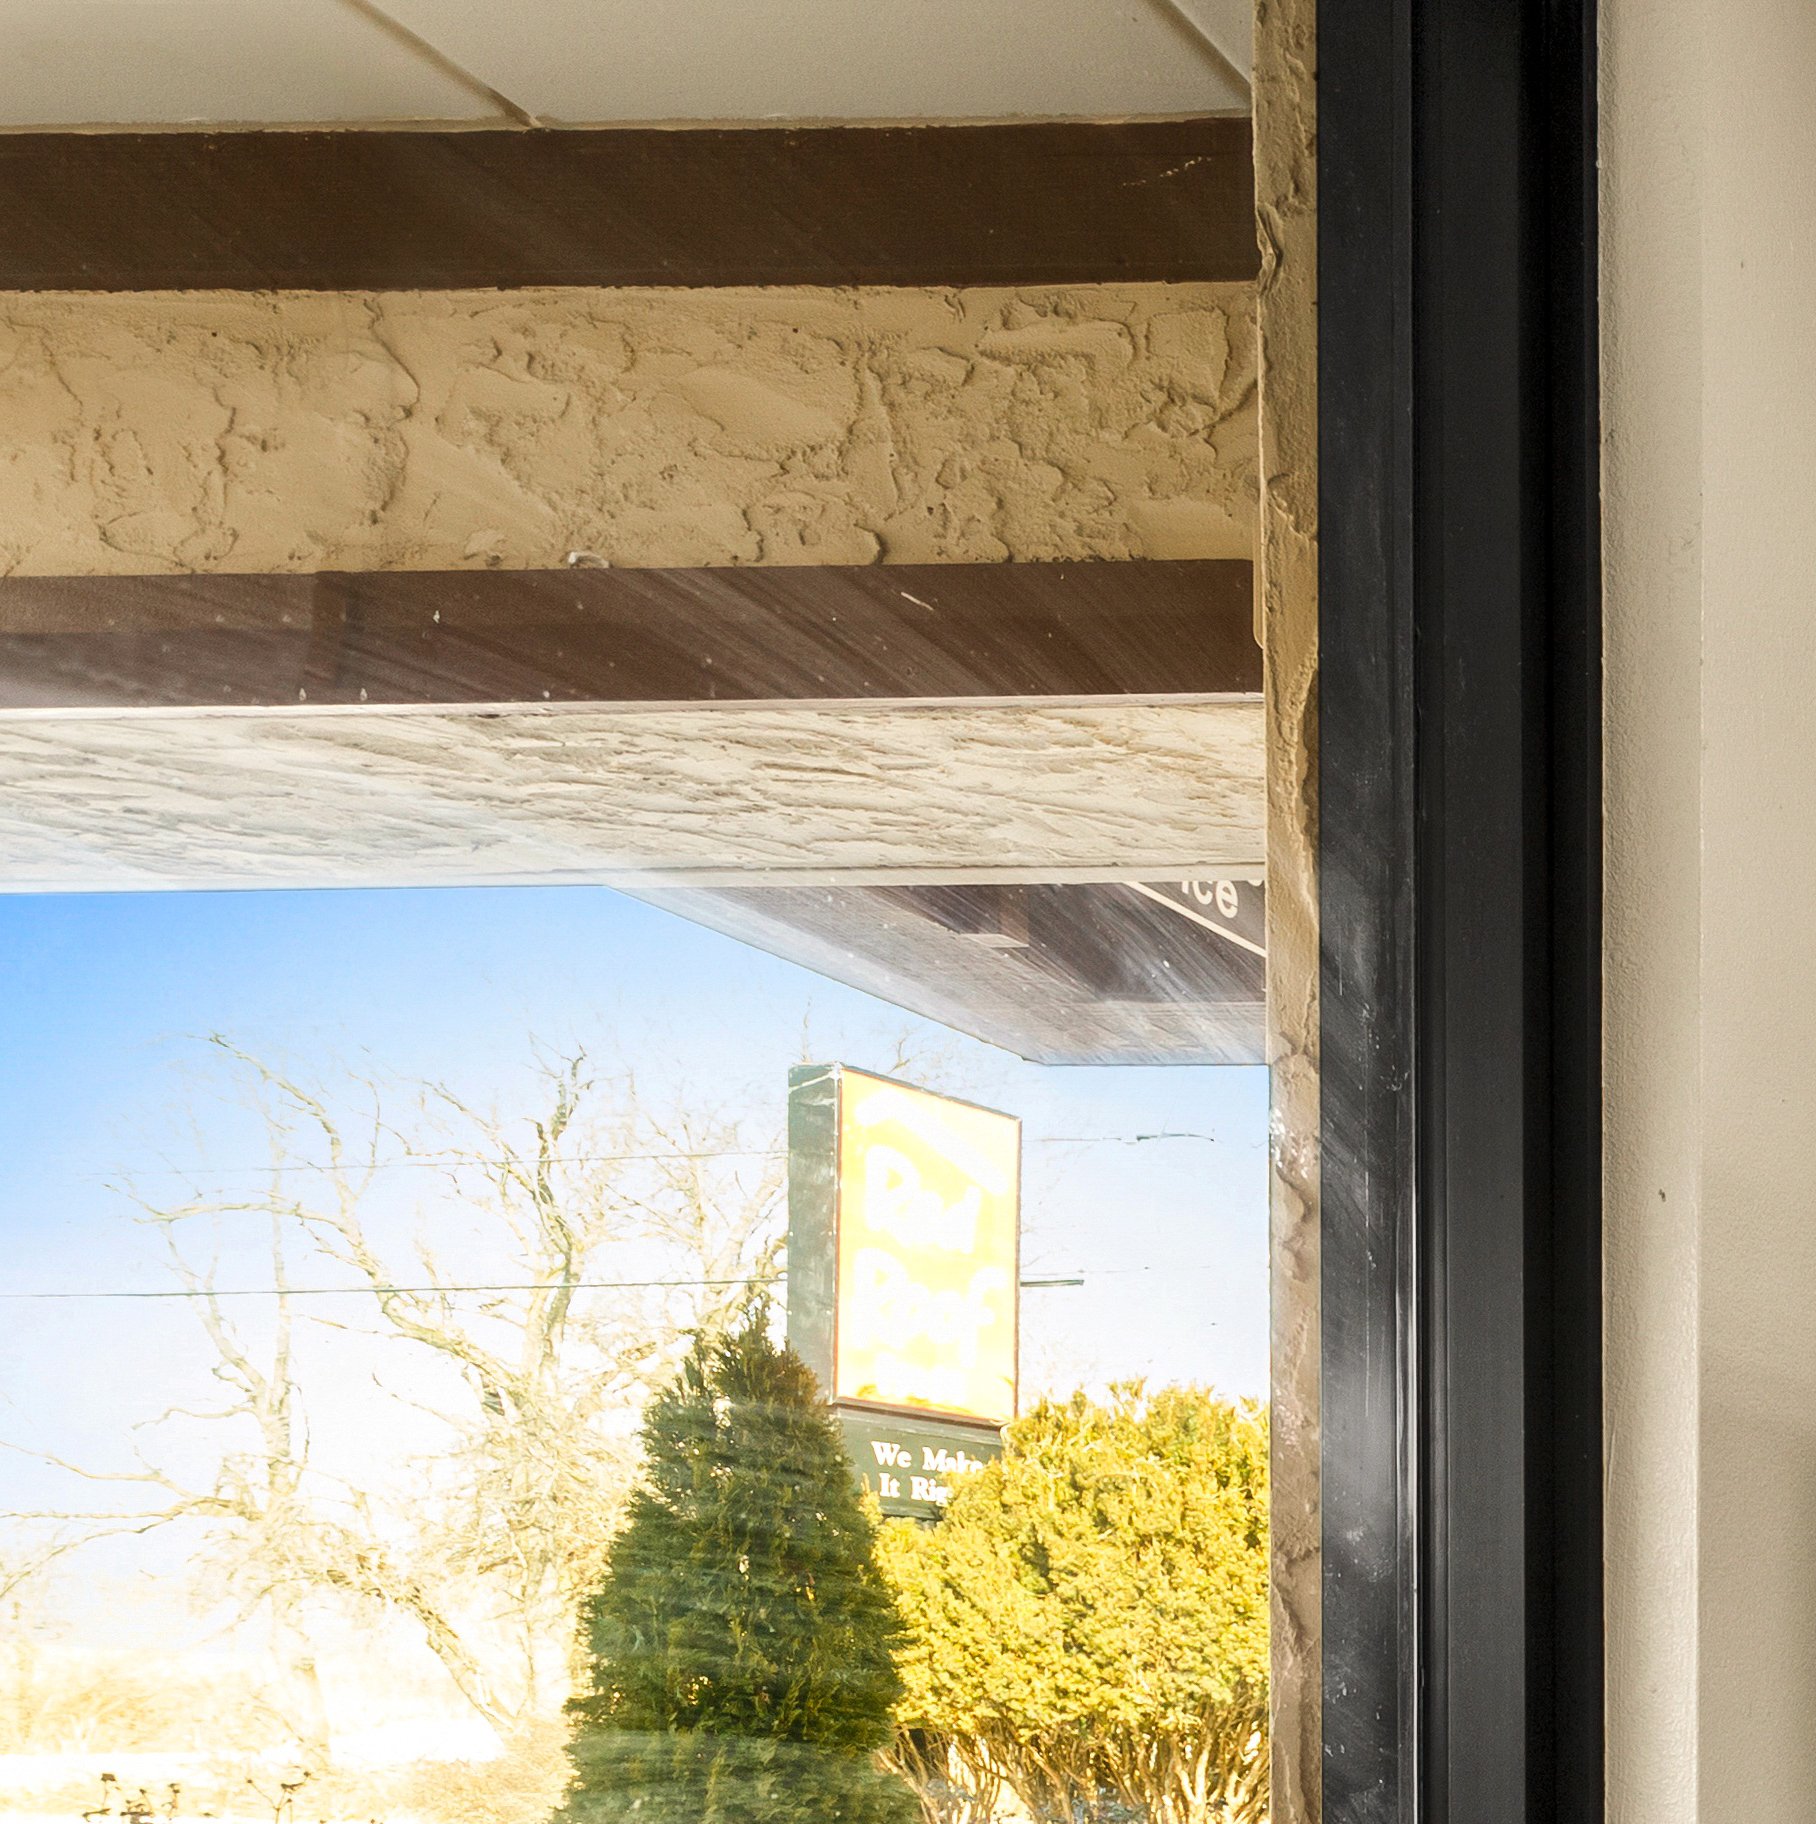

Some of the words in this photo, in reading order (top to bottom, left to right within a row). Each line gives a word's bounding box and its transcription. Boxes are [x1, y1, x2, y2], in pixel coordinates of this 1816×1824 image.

[871, 1441, 912, 1468] We
[922, 1446, 984, 1473] Make
[879, 1472, 900, 1498] It
